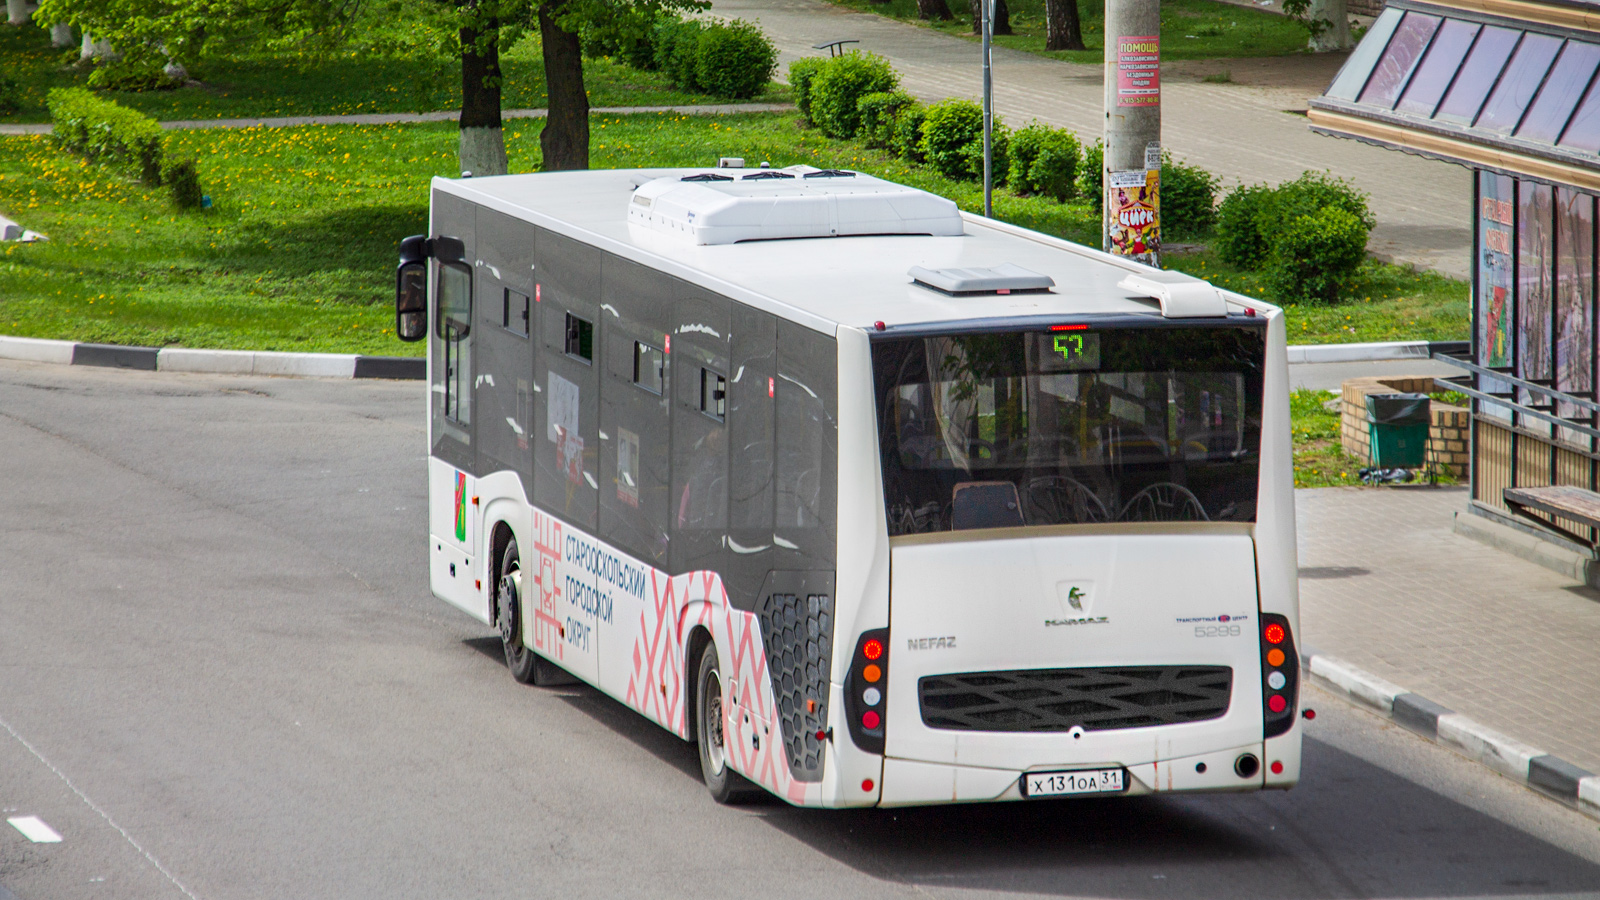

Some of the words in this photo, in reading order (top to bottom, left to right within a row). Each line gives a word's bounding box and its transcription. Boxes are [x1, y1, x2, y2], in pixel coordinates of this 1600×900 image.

[1120, 43, 1159, 53] ПОМОЩЬ
[1119, 209, 1154, 227] ЦИРК
[565, 534, 646, 602] СТАРООСКОЛЬСКИЙ
[565, 575, 613, 626] ГОРОДСКОЙ
[566, 616, 591, 653] ОКРУГ
[1194, 625, 1241, 638] 5299
[907, 636, 957, 650] NEFAZ
[1102, 771, 1117, 784] 31
